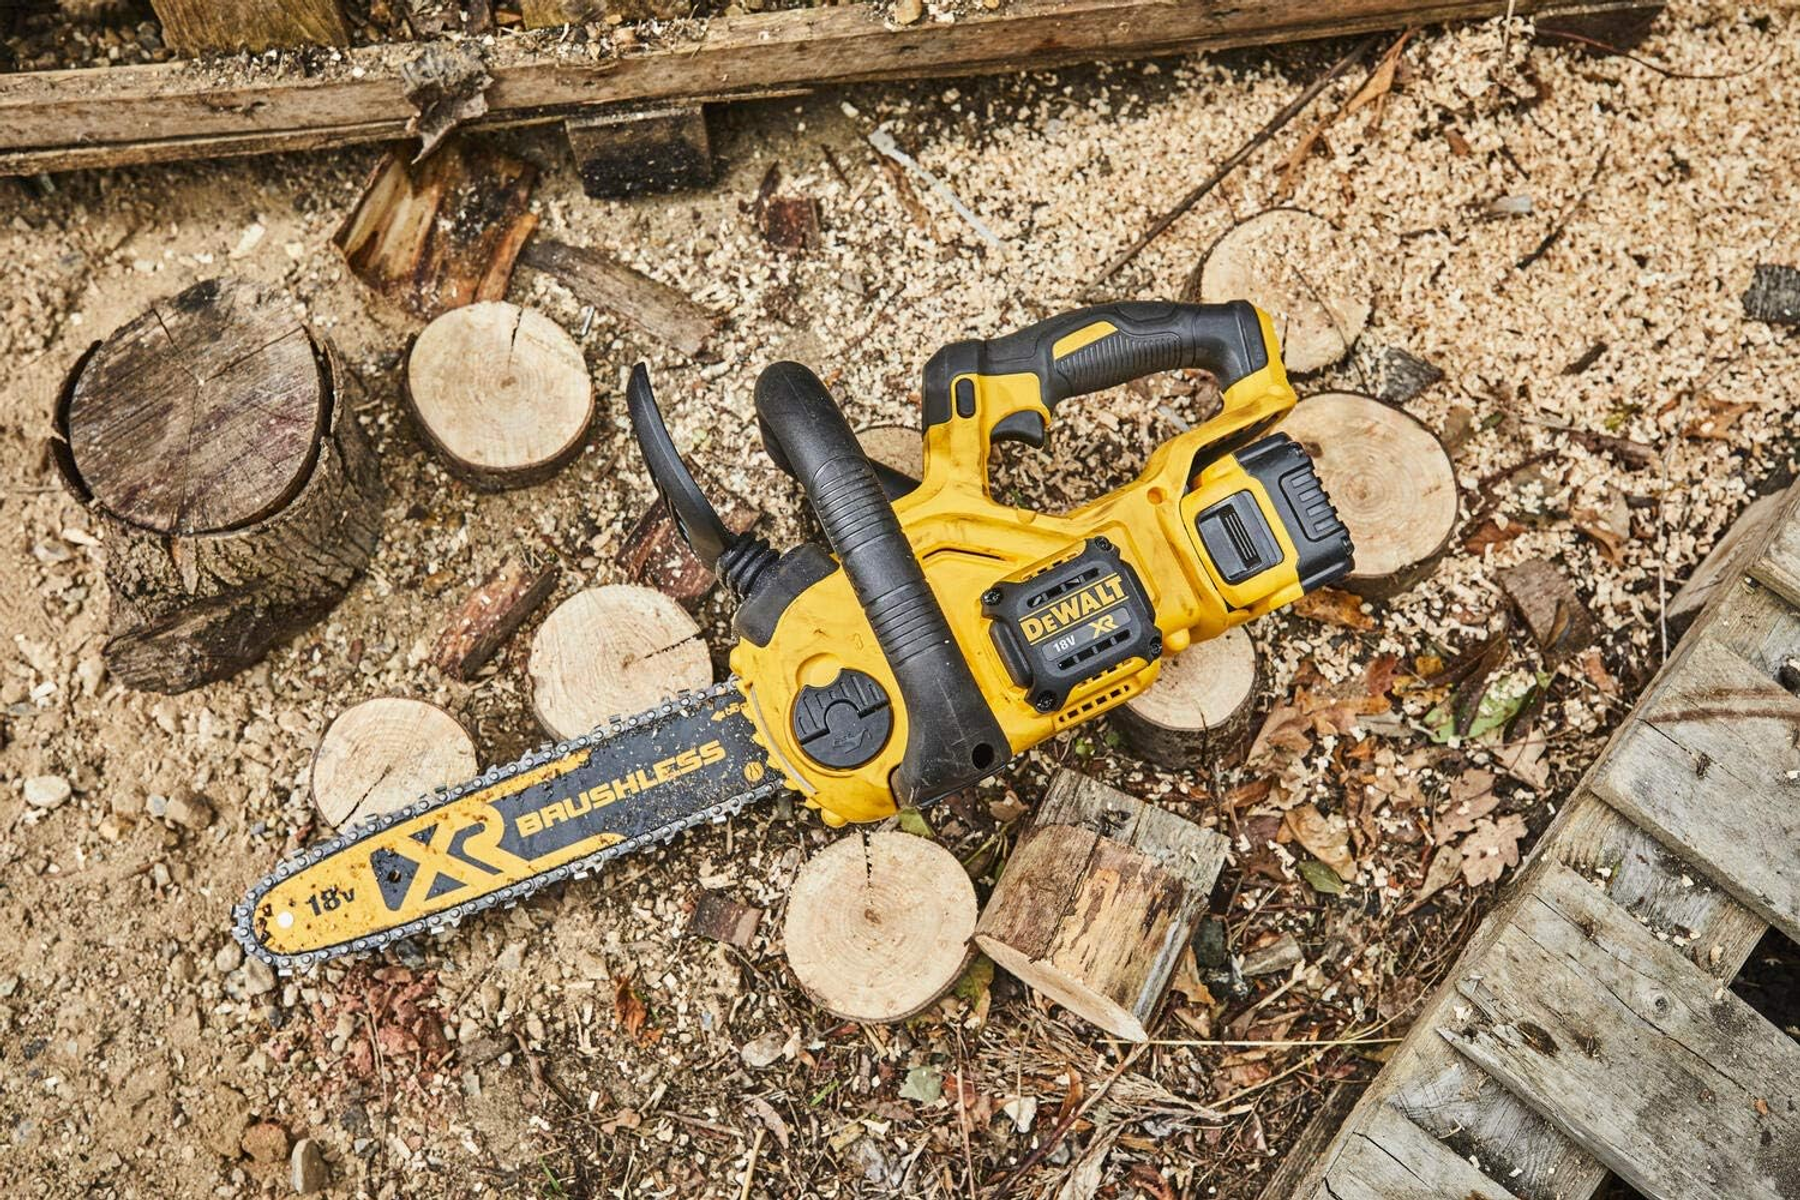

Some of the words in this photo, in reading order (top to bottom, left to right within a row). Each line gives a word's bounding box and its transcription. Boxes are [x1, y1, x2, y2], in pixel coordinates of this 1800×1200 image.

[1053, 636, 1076, 653] 18V
[1089, 615, 1119, 638] XR
[370, 797, 530, 912] XR
[515, 739, 726, 838] BRUSHLESS
